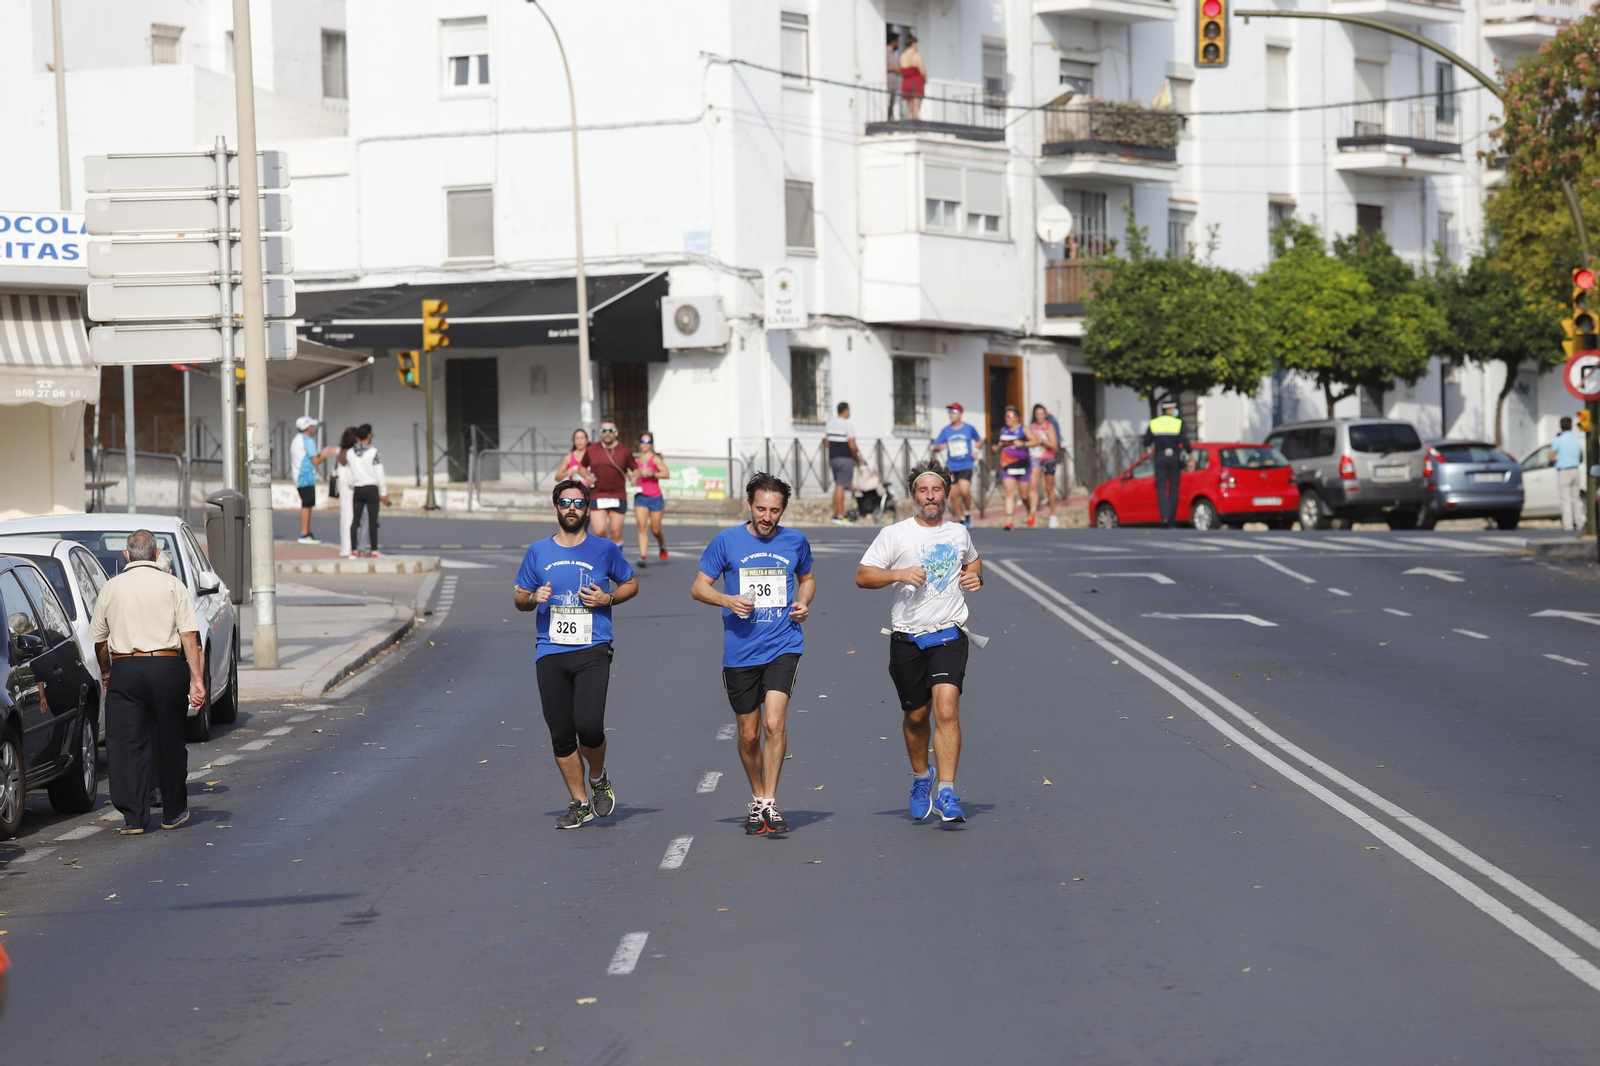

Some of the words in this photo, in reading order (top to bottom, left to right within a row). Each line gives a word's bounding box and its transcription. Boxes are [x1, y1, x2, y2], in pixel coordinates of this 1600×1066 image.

[0, 241, 80, 261] ITAS
[15, 388, 34, 398] 959
[37, 388, 50, 399] 27
[52, 389, 66, 399] 06
[556, 620, 577, 634] 326
